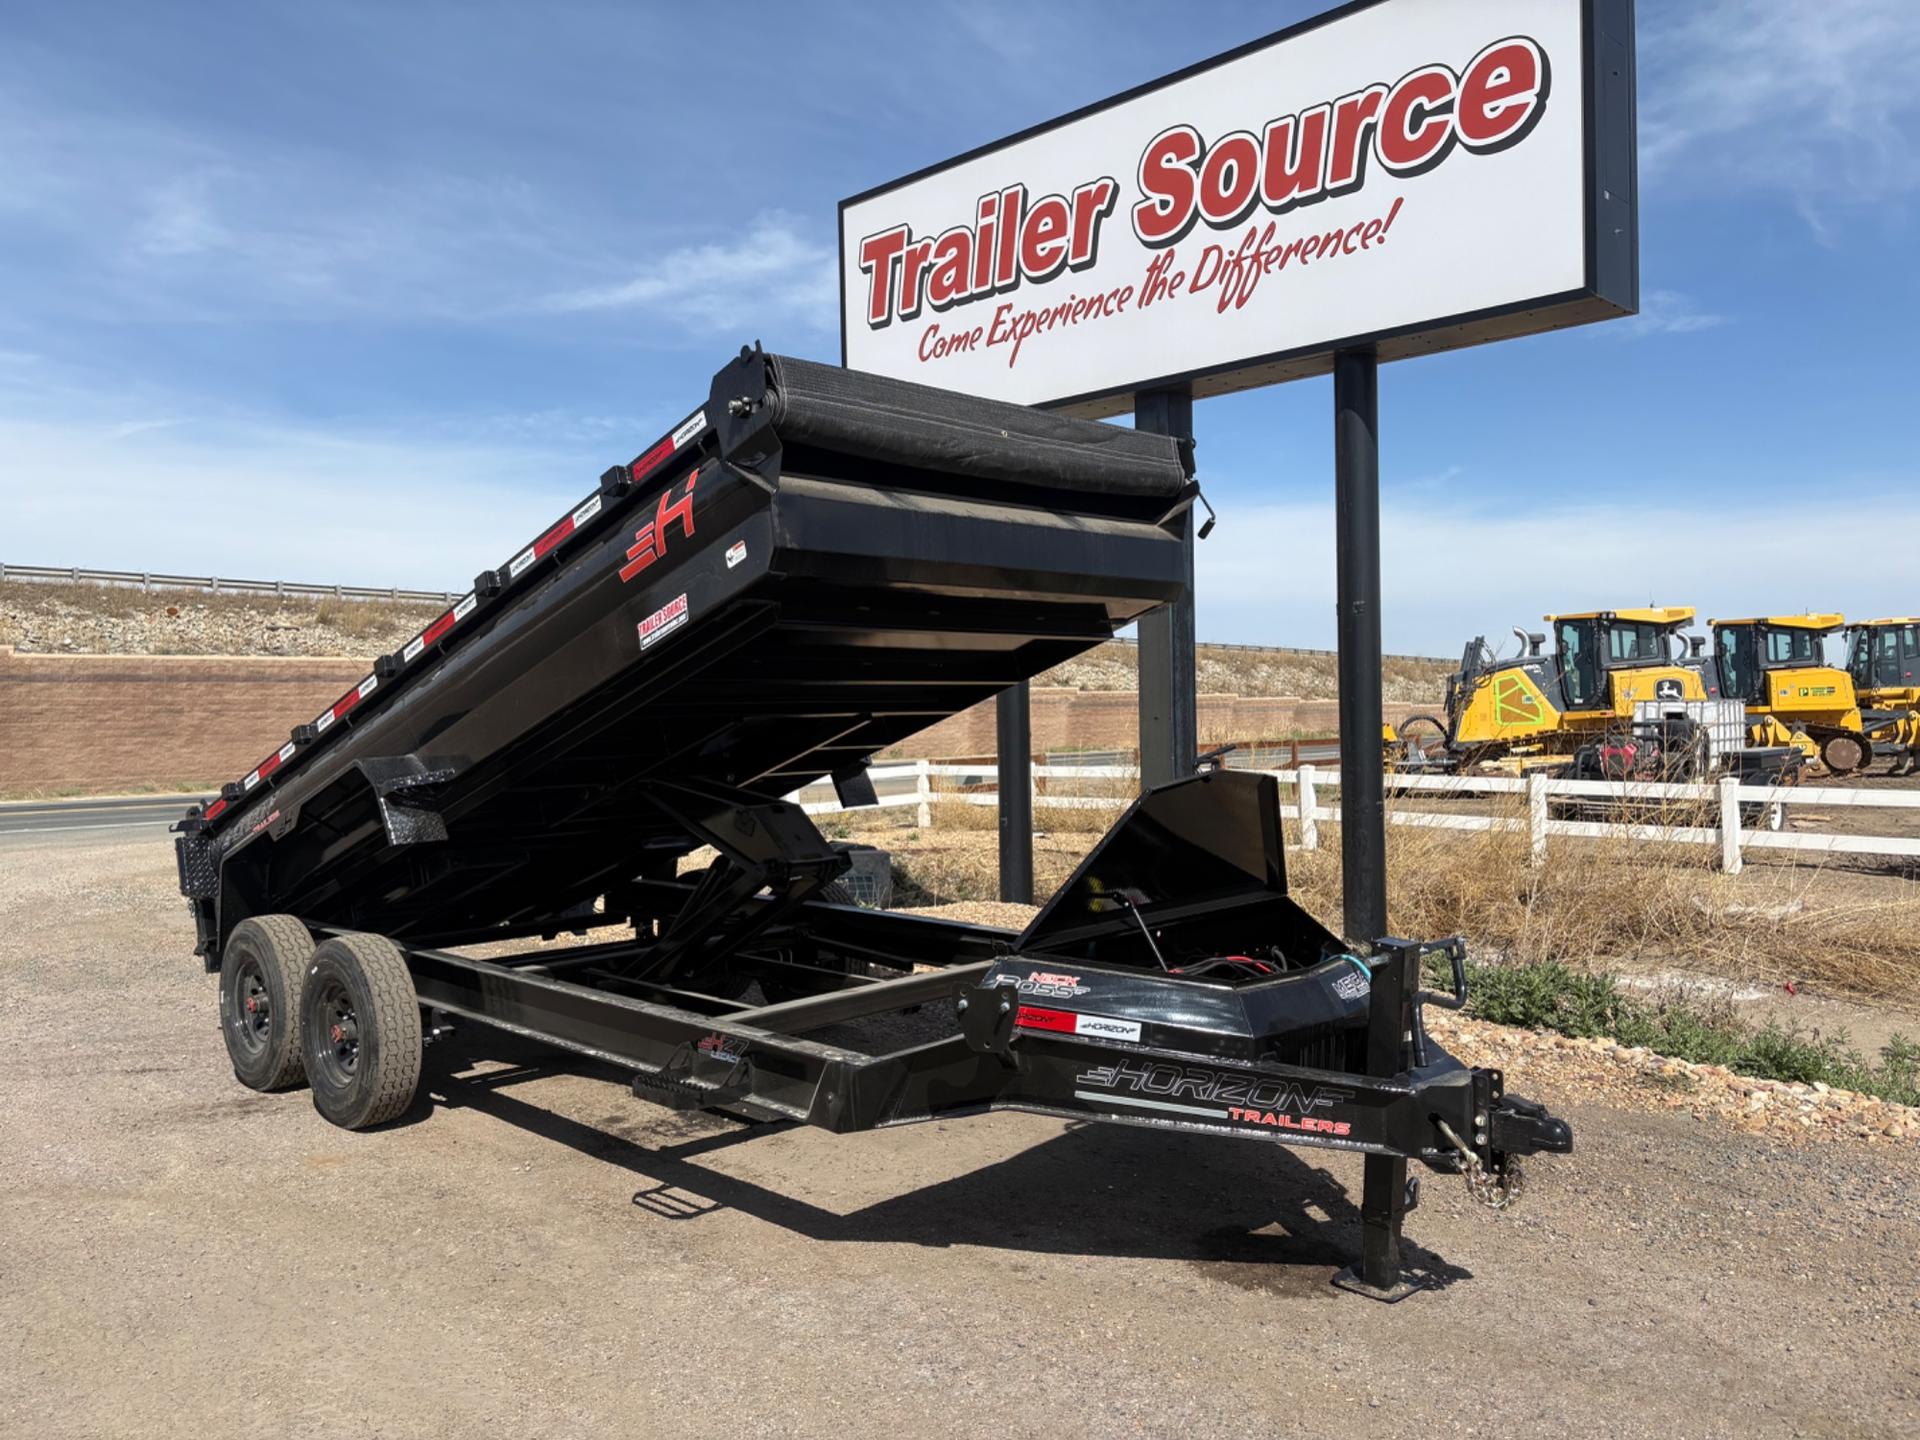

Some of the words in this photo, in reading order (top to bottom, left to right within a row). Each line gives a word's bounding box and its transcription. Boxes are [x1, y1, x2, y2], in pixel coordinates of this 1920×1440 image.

[859, 176, 1119, 330] Trailer
[1131, 35, 1551, 250] Source
[918, 322, 983, 362] Come
[986, 285, 1134, 368] Experience
[1138, 248, 1185, 310] the
[1189, 197, 1404, 314] Difference!
[1029, 971, 1080, 986] NECK
[1084, 1022, 1134, 1034] HORIZON
[1103, 1058, 1322, 1114] HORIZON
[1229, 1107, 1351, 1136] TRAILERS
